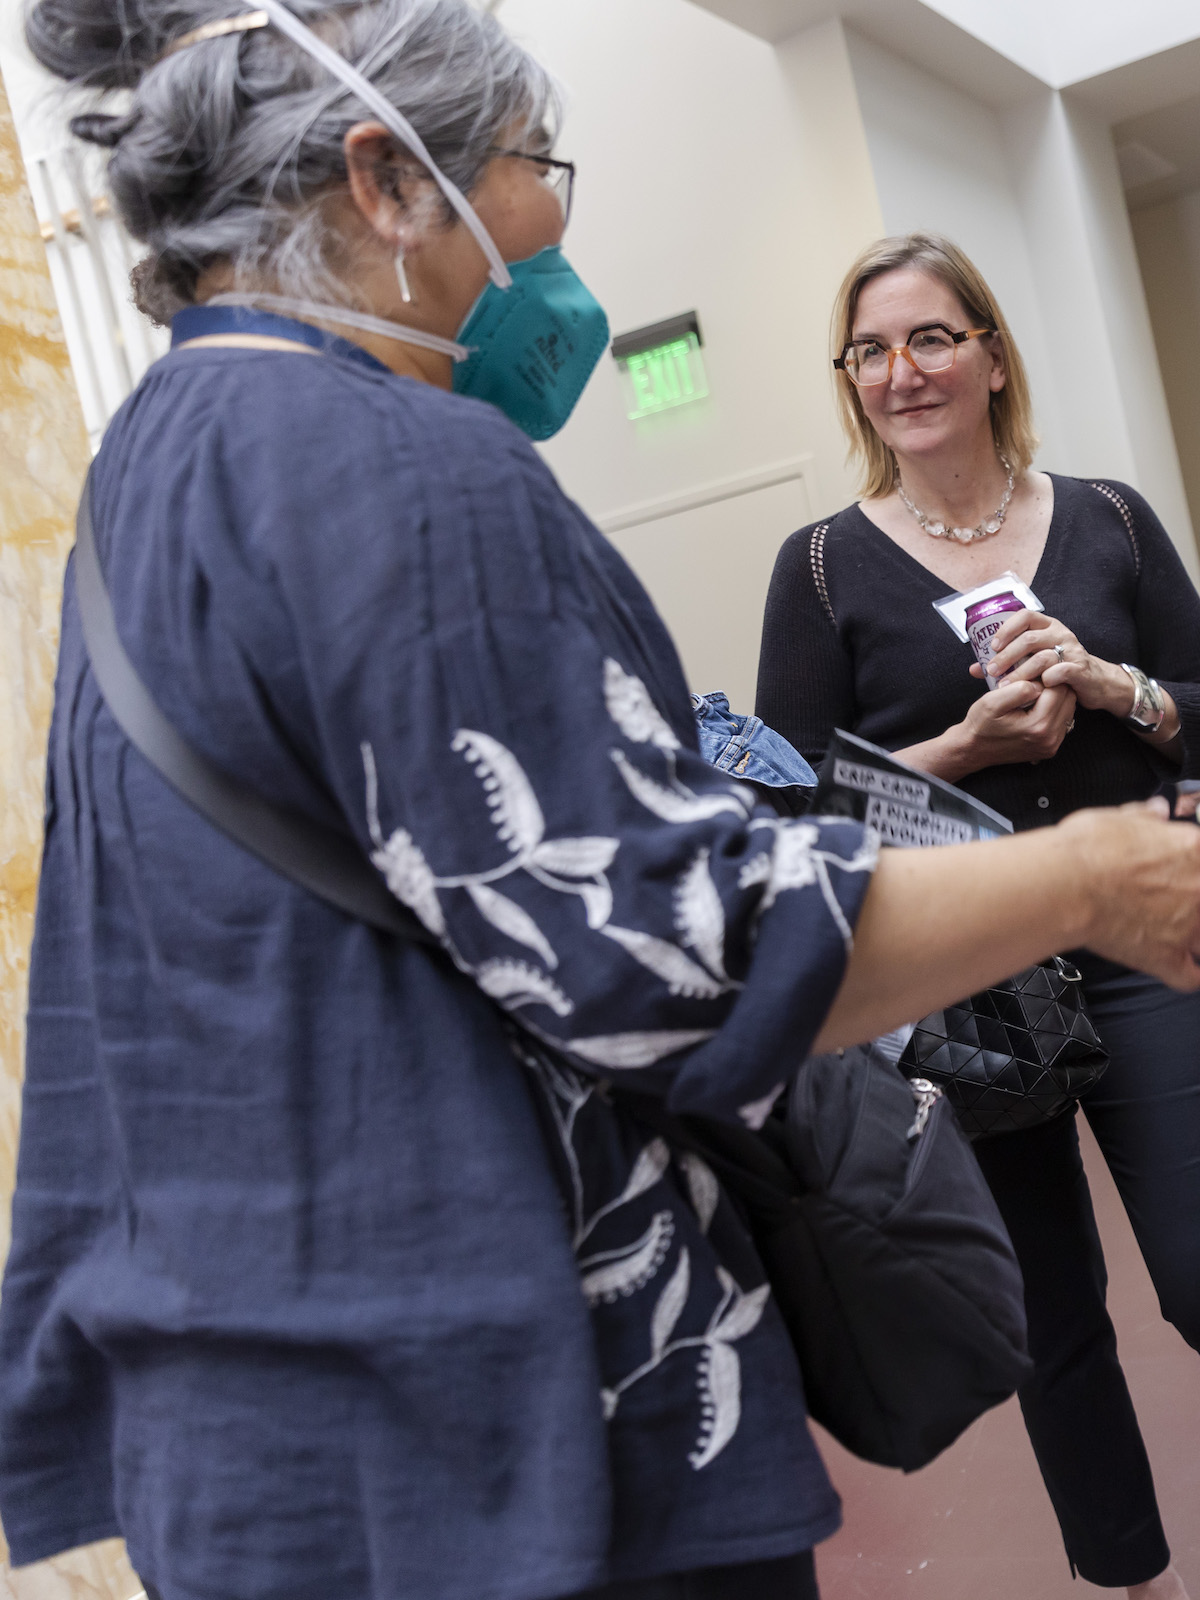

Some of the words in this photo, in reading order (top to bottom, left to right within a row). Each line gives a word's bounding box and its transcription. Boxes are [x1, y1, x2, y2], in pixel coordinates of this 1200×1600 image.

[627, 339, 694, 410] EXIT
[838, 764, 876, 787] CRIP
[880, 777, 925, 801] CAMP
[887, 804, 969, 841] DISABILITY
